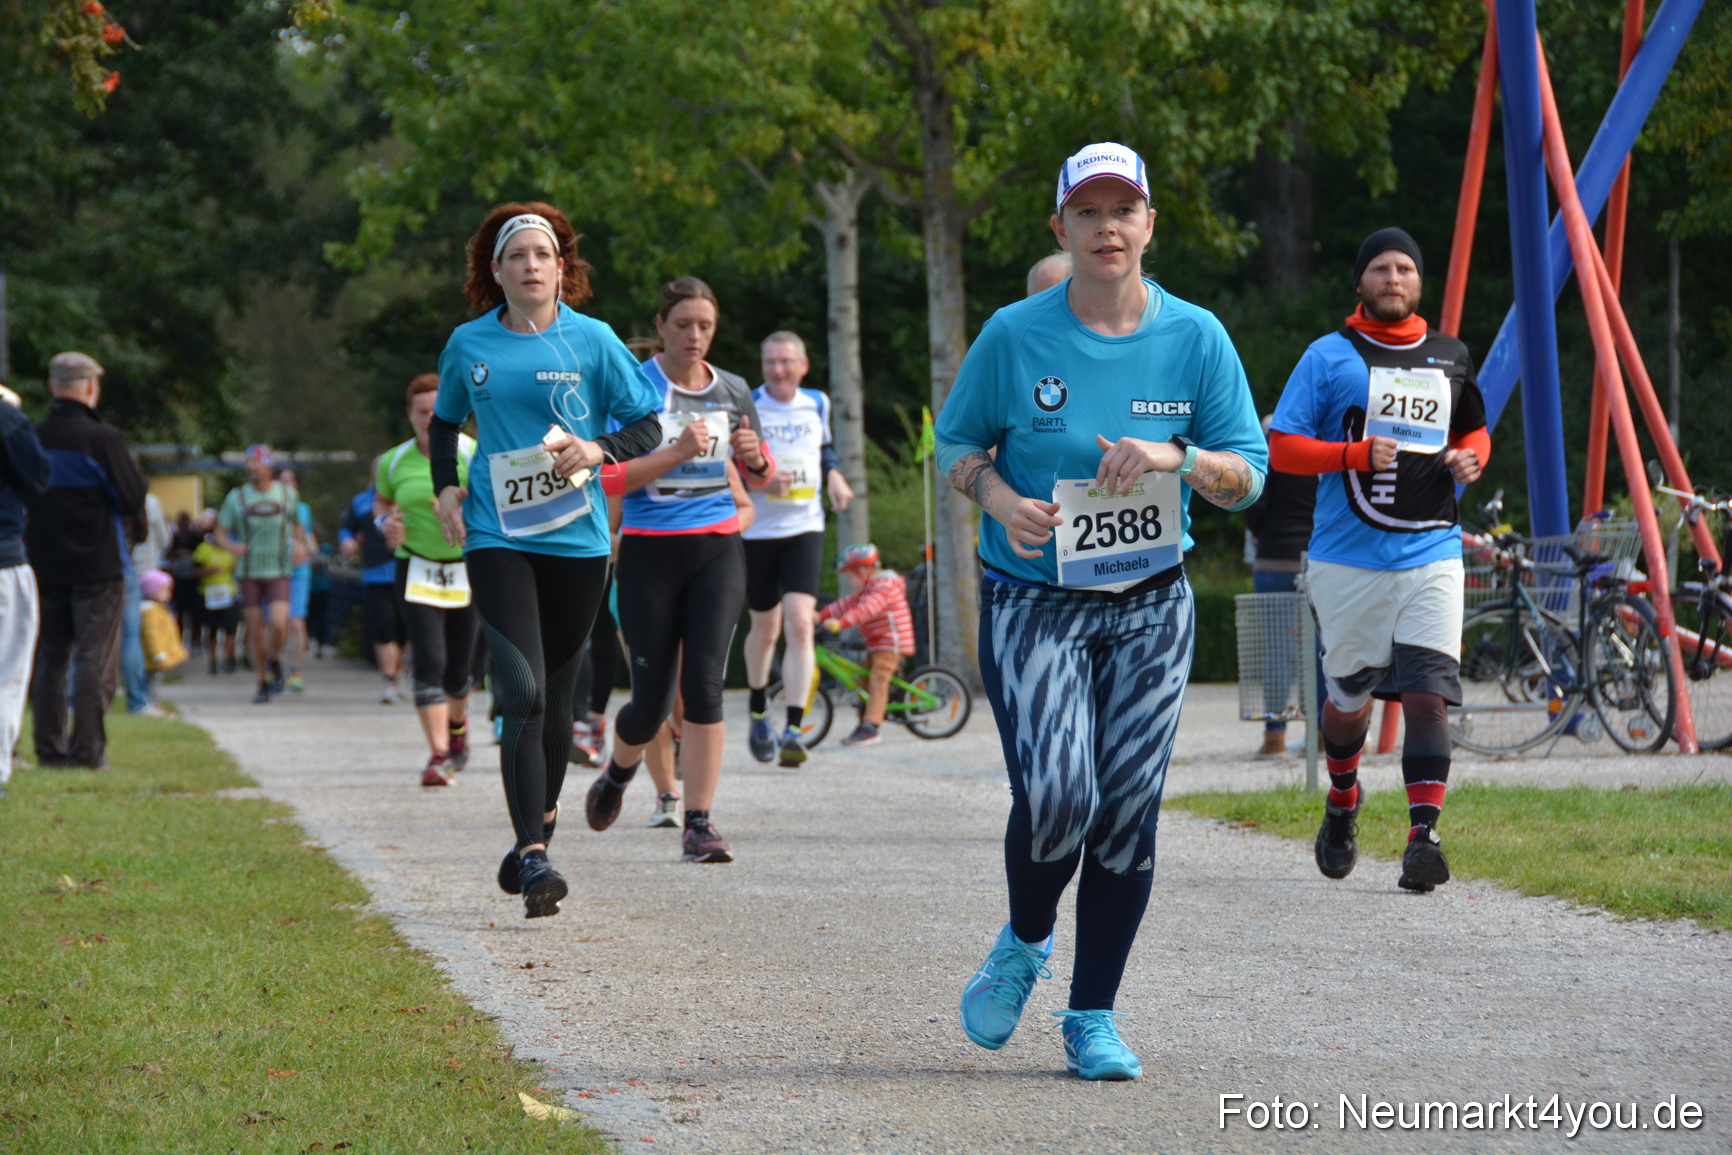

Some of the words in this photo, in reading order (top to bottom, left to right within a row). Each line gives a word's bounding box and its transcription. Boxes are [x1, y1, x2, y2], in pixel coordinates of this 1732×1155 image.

[1077, 155, 1128, 168] ERDINGER
[536, 371, 581, 381] BOCK
[1037, 377, 1065, 390] BMW
[1131, 400, 1194, 415] BOCK
[1380, 393, 1438, 423] 2152
[1032, 417, 1067, 427] PARTL
[1392, 426, 1422, 439] Markus
[681, 466, 709, 475] Kathrin
[505, 469, 568, 505] 2739
[1073, 505, 1162, 552] 2588
[1094, 556, 1150, 576] Michaela
